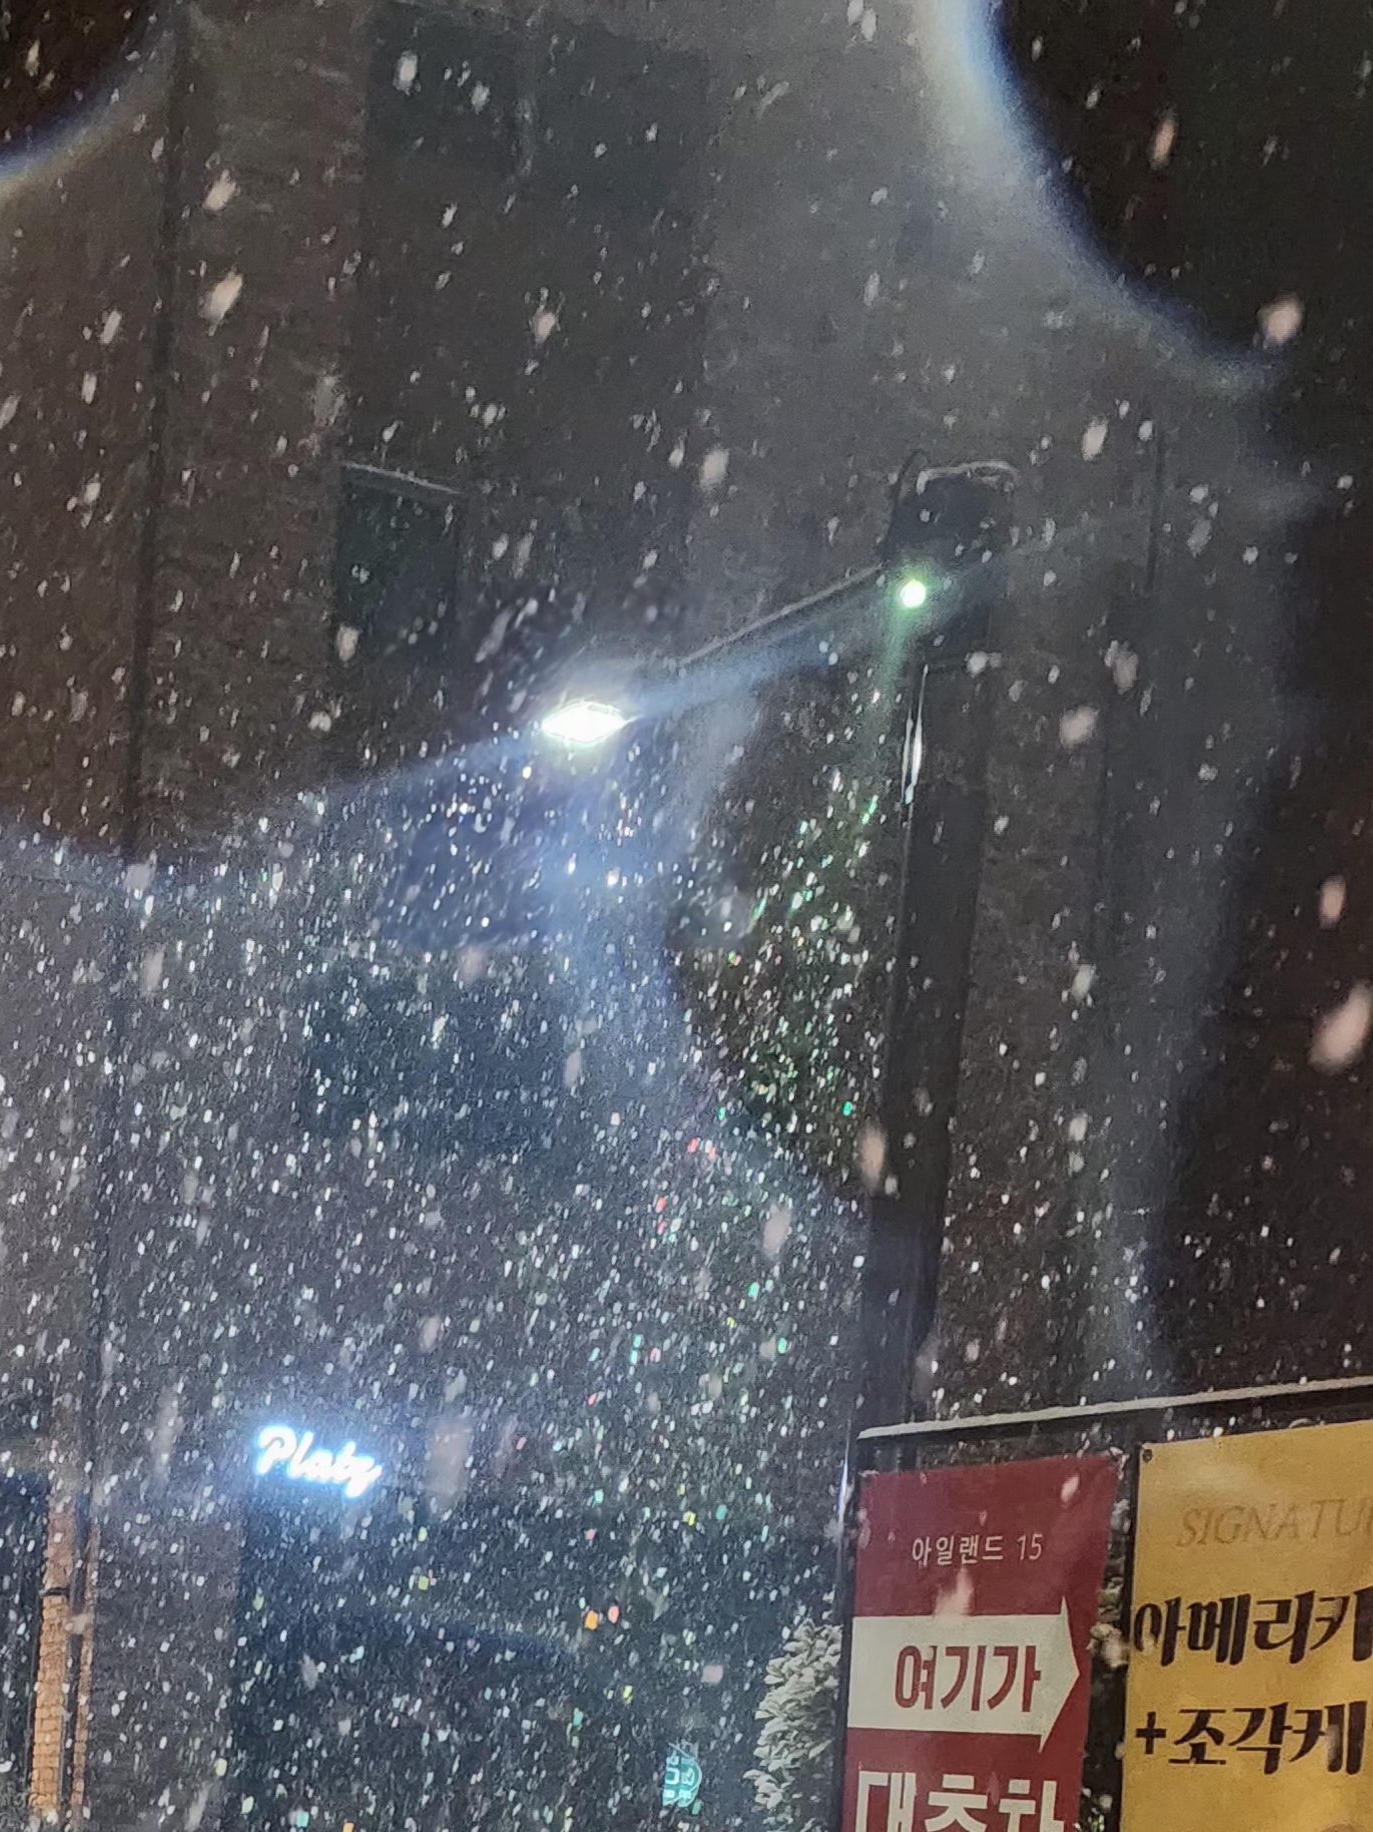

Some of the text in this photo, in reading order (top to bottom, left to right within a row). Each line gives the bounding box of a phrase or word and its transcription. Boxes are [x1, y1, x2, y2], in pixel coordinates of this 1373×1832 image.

[912, 1533, 1044, 1566] 아일랜드 15
[1176, 1497, 1373, 1547] SIGNATU
[895, 1644, 1042, 1713] 여기가
[1135, 1700, 1373, 1776] +조각케
